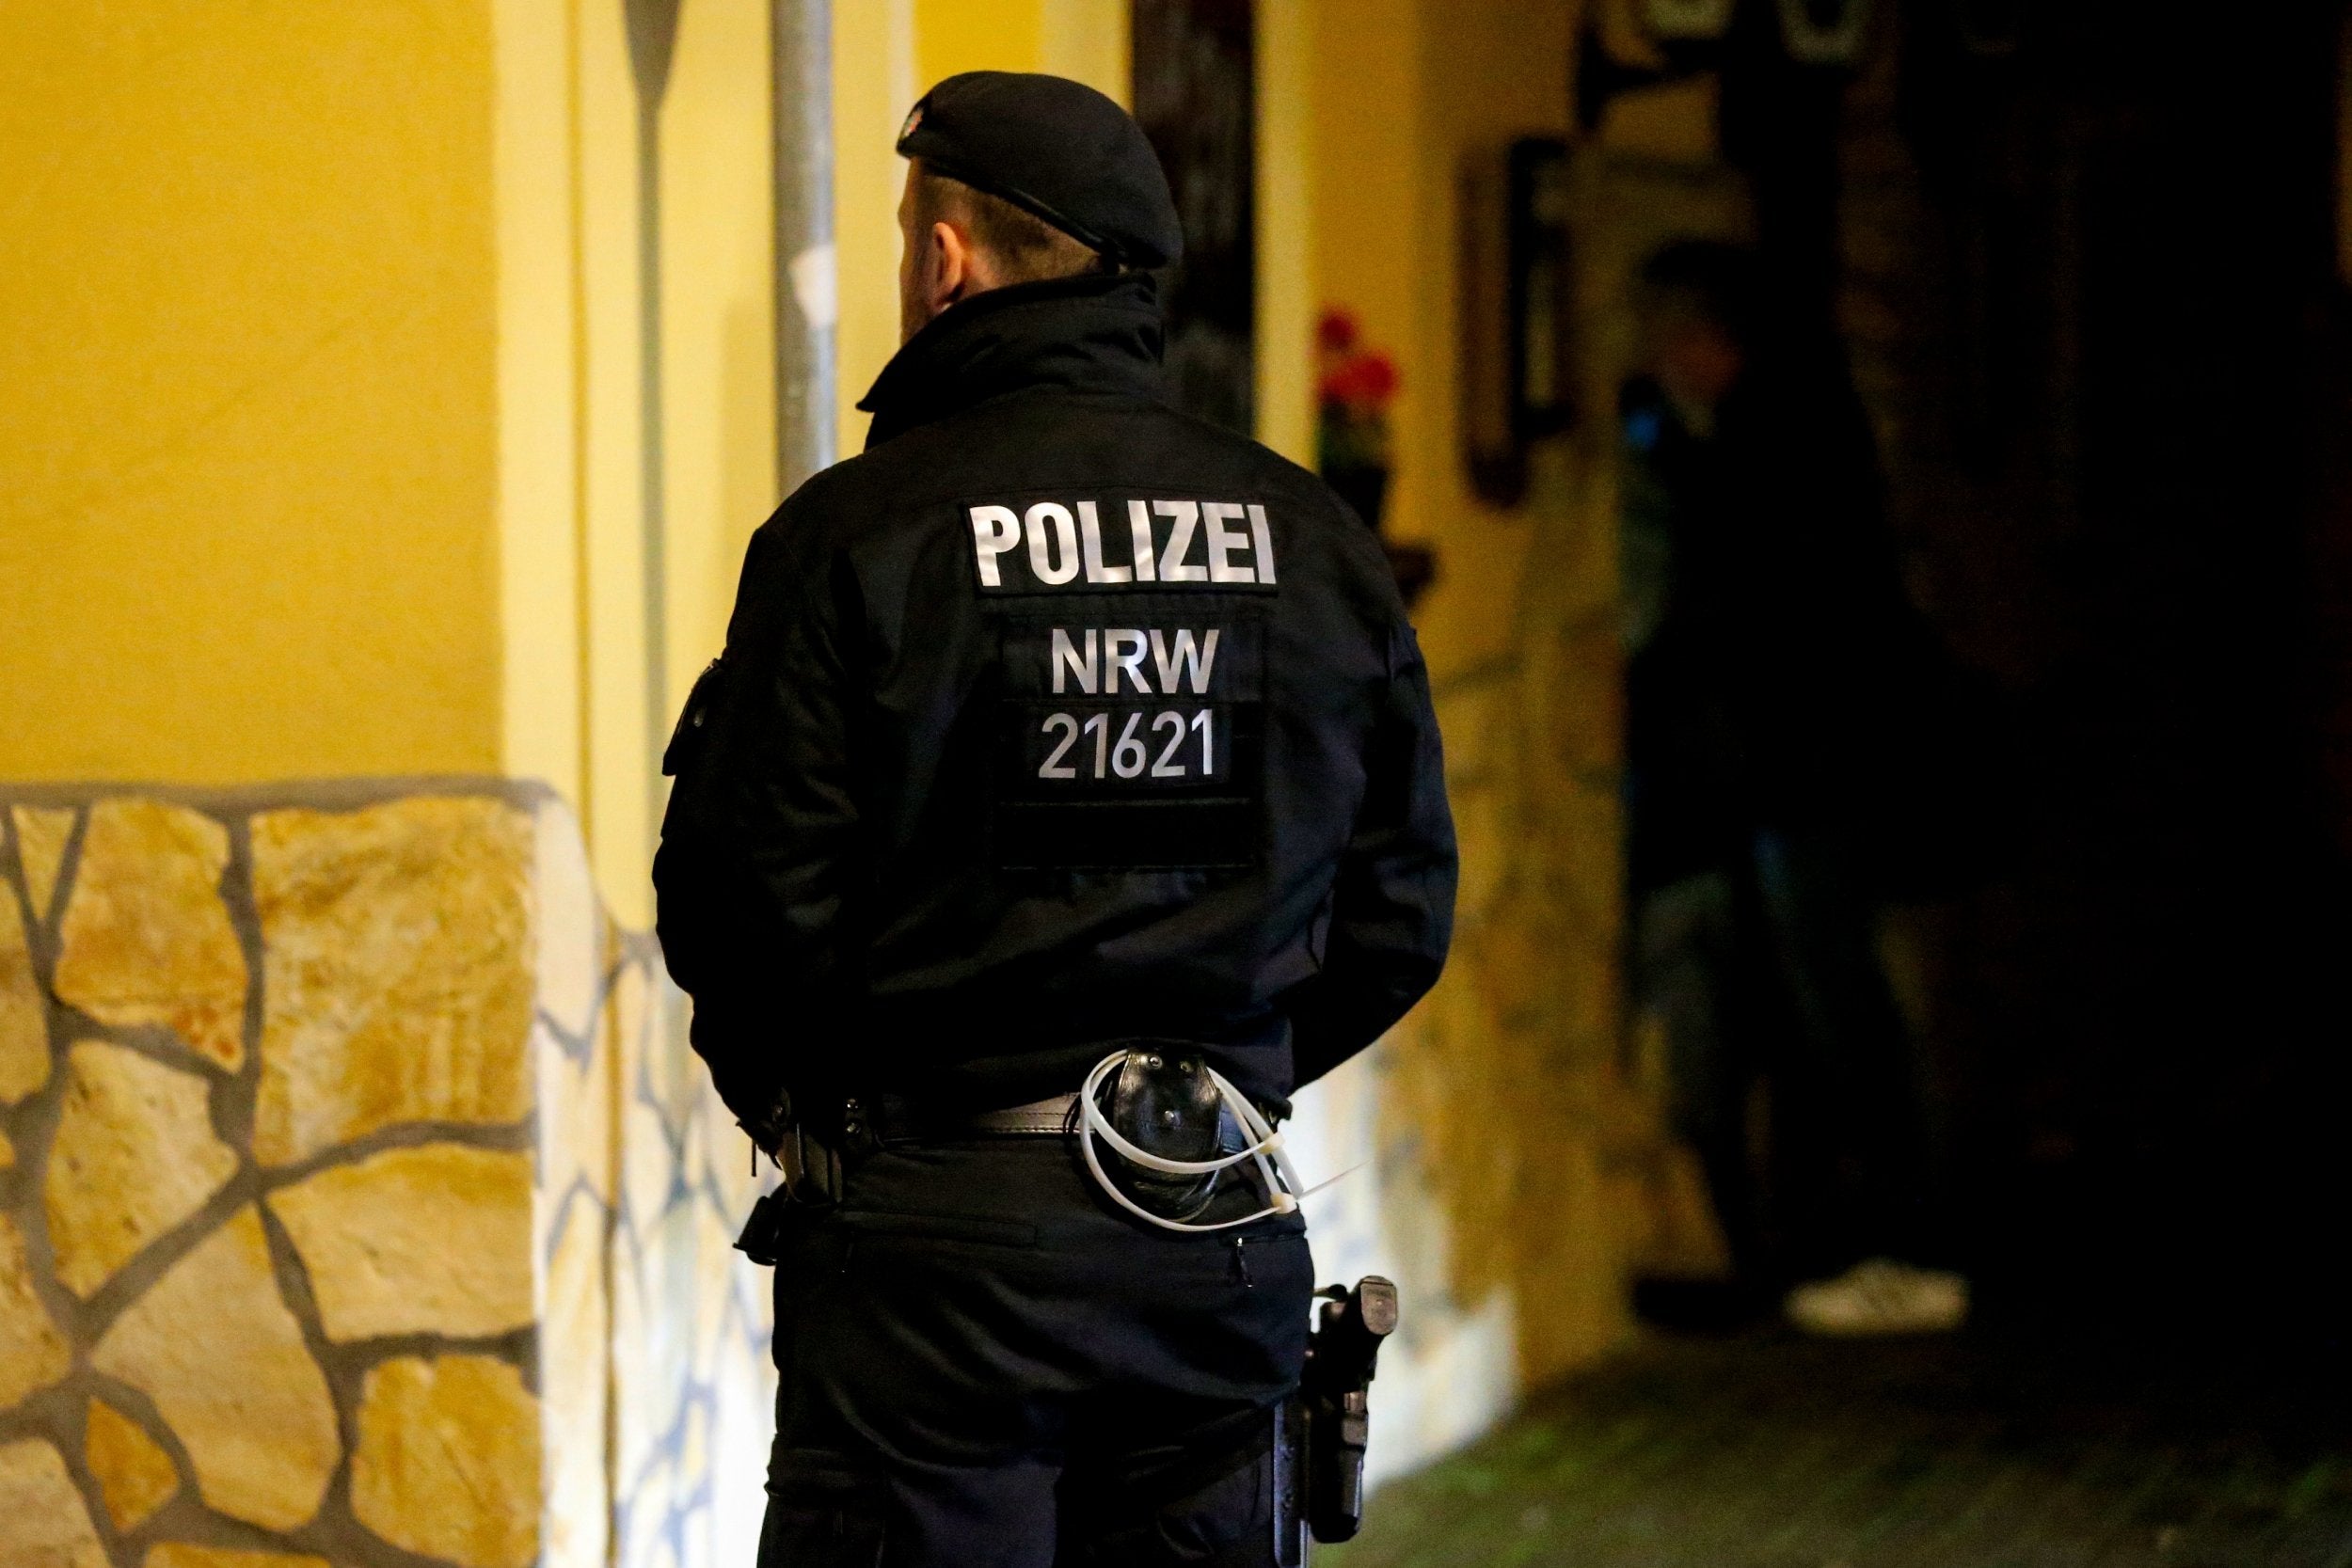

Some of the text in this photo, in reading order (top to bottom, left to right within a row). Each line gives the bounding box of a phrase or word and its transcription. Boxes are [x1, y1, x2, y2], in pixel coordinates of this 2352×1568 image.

[970, 500, 1276, 586] POLIZEI
[1052, 629, 1219, 693] NRW
[1040, 709, 1212, 778] 21621
